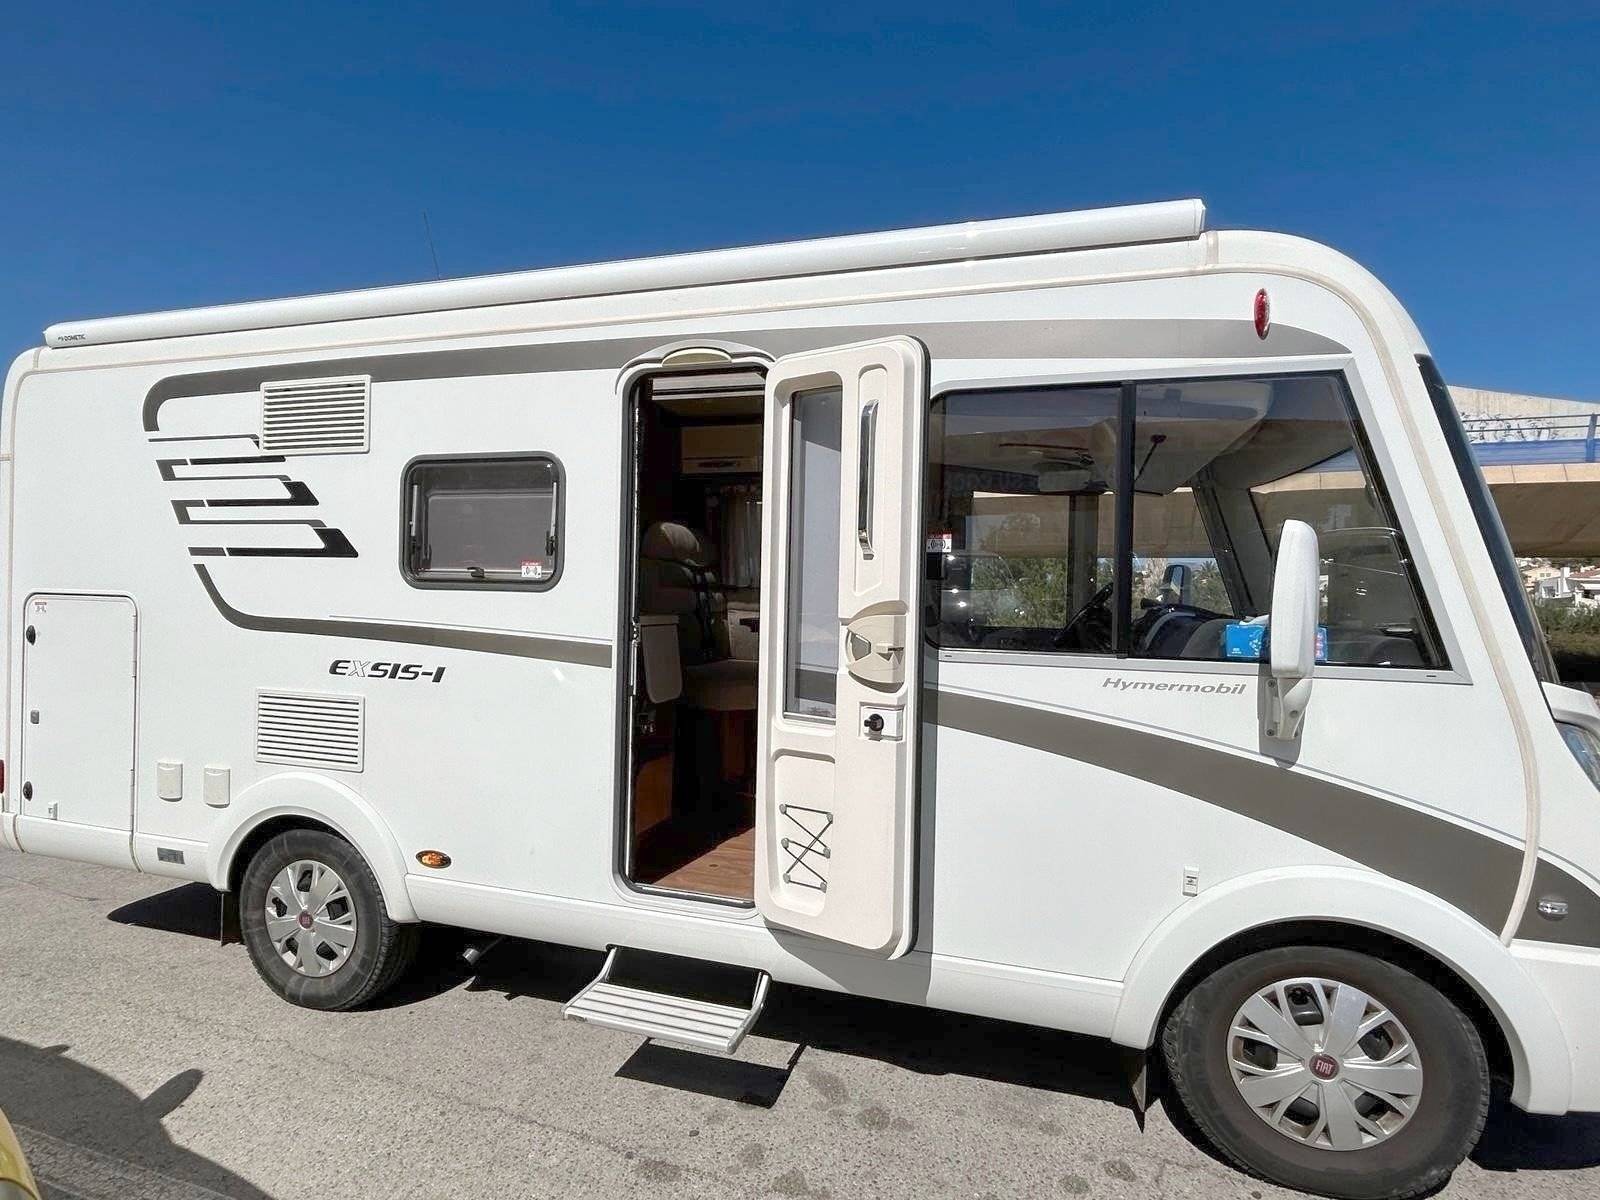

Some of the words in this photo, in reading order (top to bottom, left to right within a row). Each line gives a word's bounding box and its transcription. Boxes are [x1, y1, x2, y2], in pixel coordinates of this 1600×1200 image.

[328, 659, 446, 683] EXSIS-I
[1102, 677, 1247, 695] Hymermobil
[1315, 1059, 1335, 1075] FIAT
